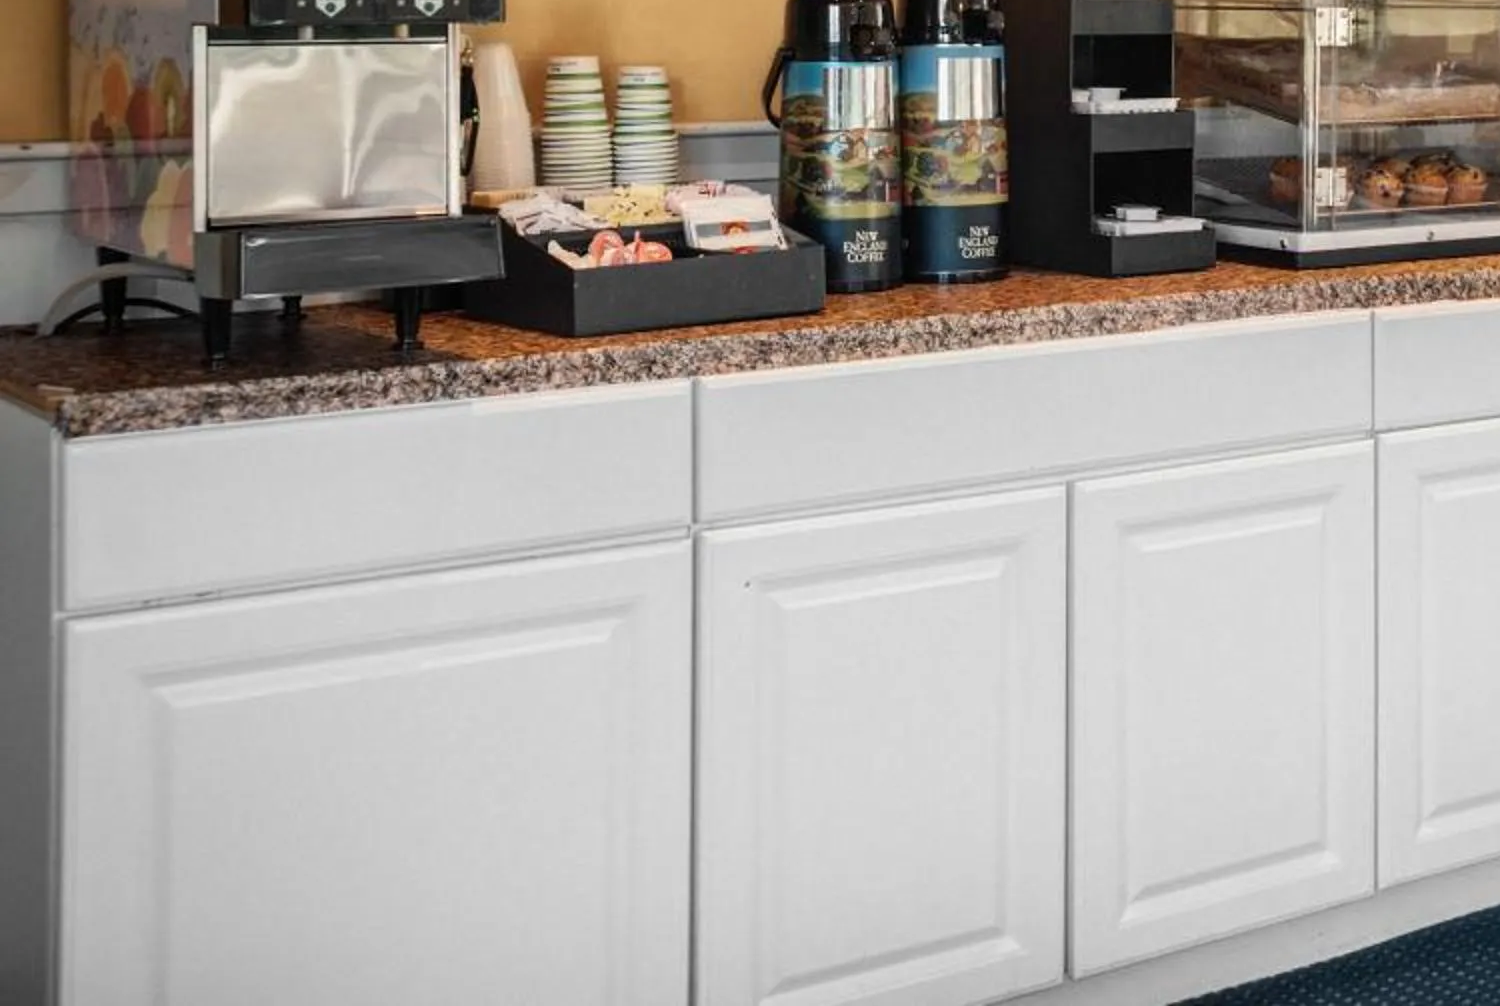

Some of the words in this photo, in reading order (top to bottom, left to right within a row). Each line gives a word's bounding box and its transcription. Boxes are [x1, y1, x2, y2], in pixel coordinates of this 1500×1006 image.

[855, 230, 879, 242] NEW
[969, 225, 990, 237] NEW
[843, 241, 888, 254] ENGLAND
[959, 236, 999, 249] ENGLAND
